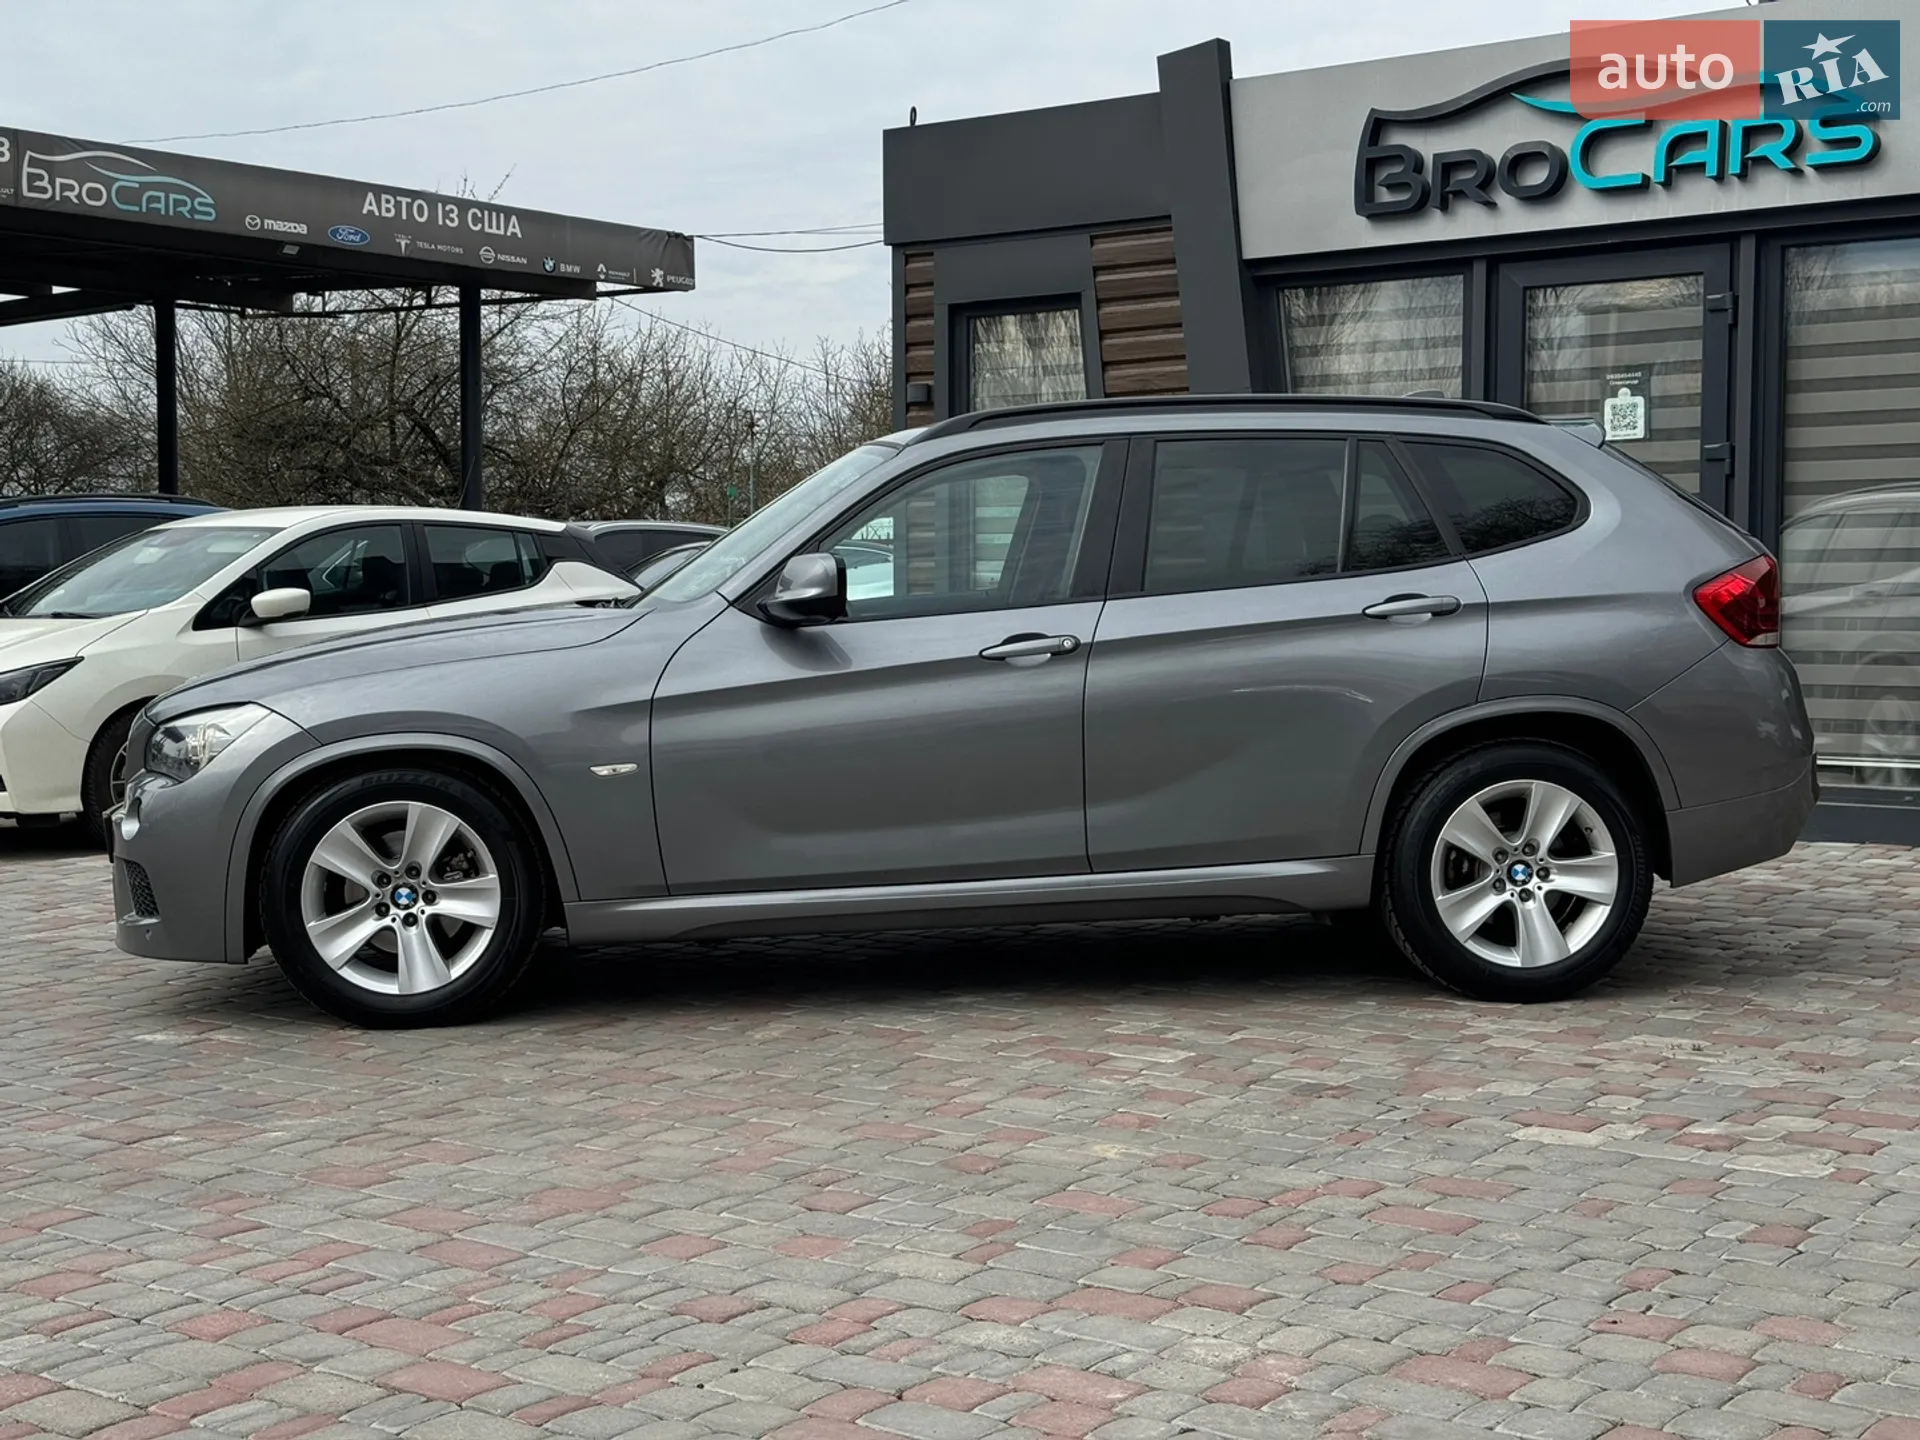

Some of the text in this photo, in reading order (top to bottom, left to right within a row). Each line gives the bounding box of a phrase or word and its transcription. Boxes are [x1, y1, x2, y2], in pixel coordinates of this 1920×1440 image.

[362, 191, 523, 239] АВТО ІЗ США
[263, 218, 308, 235] mazda
[335, 226, 362, 243] Ford
[416, 241, 464, 255] TESLA MOTORS
[497, 253, 528, 264] NISSAN
[559, 262, 582, 274] BMW
[666, 274, 695, 286] PEUGEO
